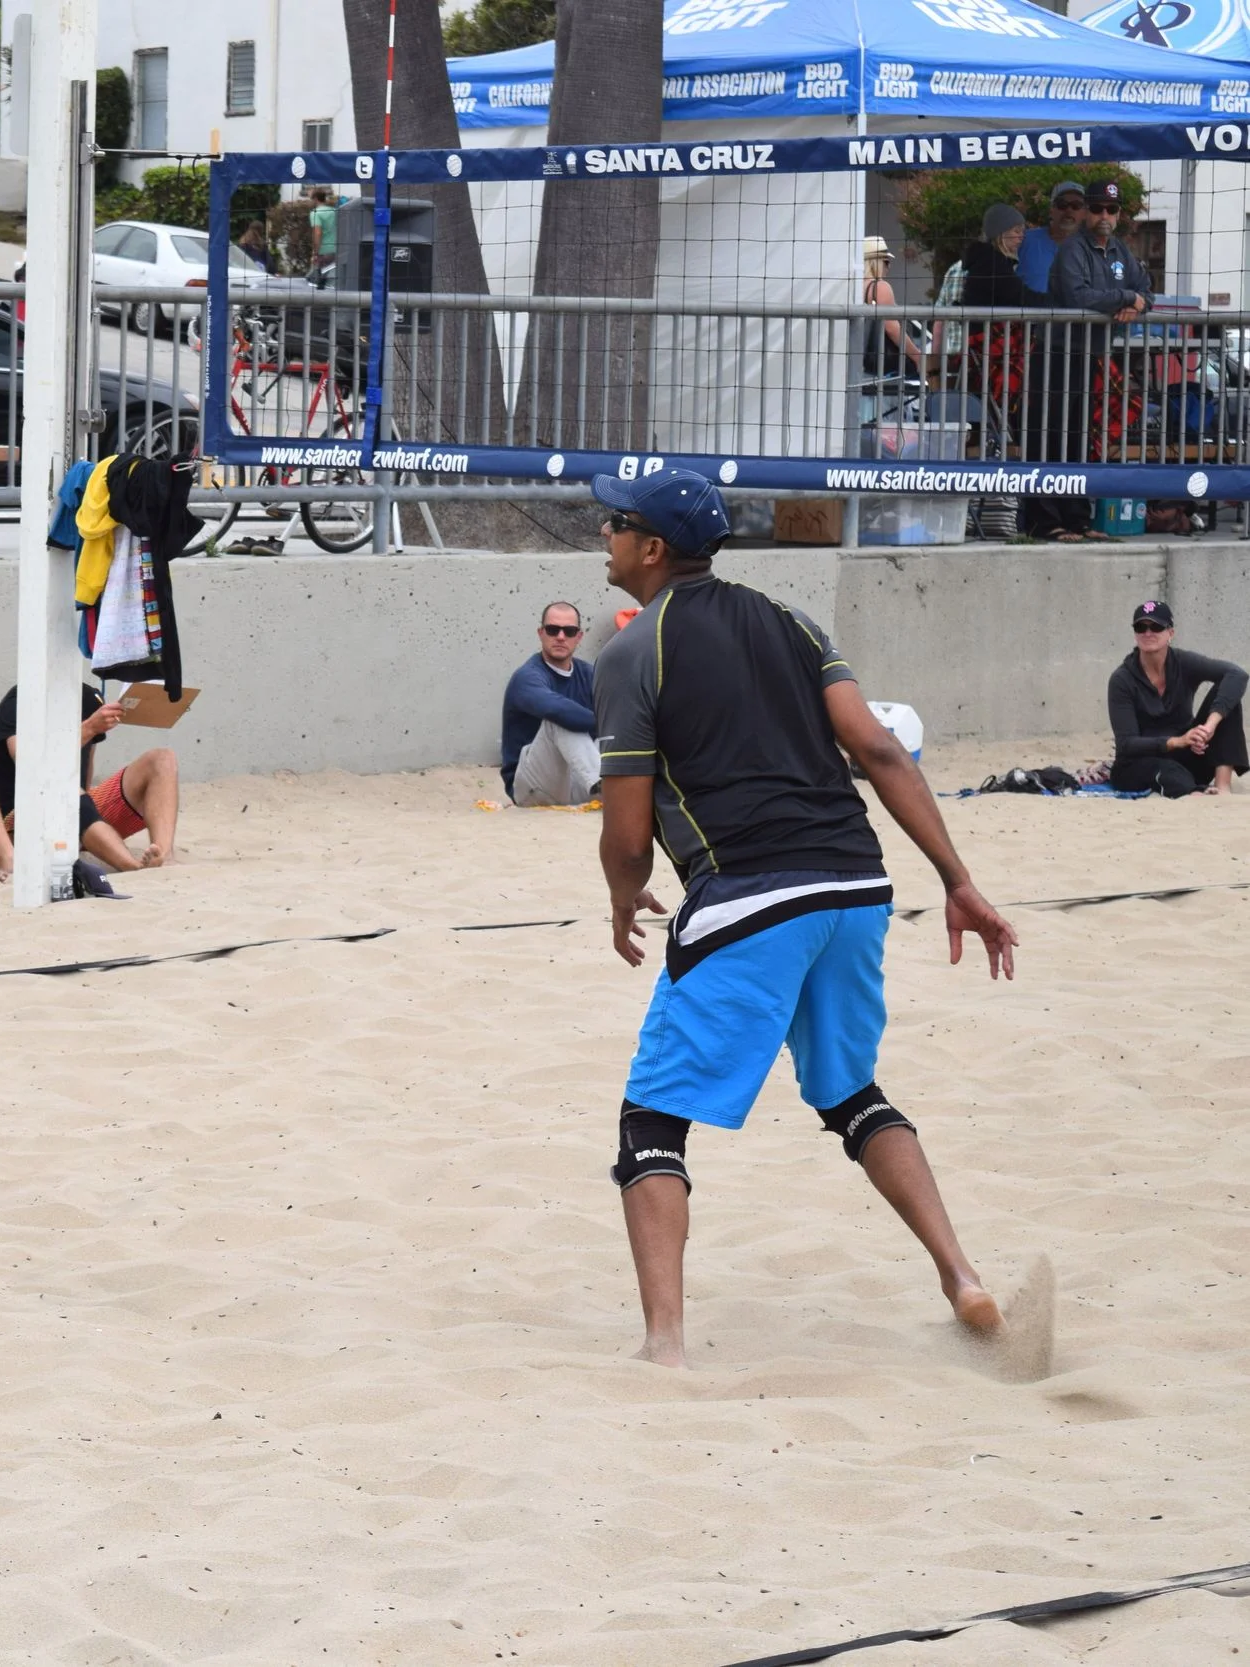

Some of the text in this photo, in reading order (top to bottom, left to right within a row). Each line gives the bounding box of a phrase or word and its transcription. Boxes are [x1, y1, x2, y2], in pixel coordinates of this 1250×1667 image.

[912, 1, 1062, 39] LIGHT
[691, 71, 786, 98] ASSOCIATION
[805, 63, 843, 81] BUD
[879, 63, 914, 81] BUD
[488, 83, 553, 108] CALIFORN
[797, 79, 849, 99] LIGHT
[874, 80, 919, 98] LIGHT
[930, 70, 1204, 106] CALIFORNIA BEACH VOLLEYBALL ASSOCIATION
[1217, 80, 1249, 97] BUD
[585, 148, 683, 174] SANTA
[691, 145, 776, 169] CRUZ
[849, 138, 943, 165] MAIN
[959, 131, 1092, 162] BEACH
[1186, 124, 1250, 152] VO
[261, 446, 468, 473] www.santacrzwharf.com
[826, 466, 1086, 495] www.santacruzwharf.com
[849, 1103, 892, 1131] Mueller
